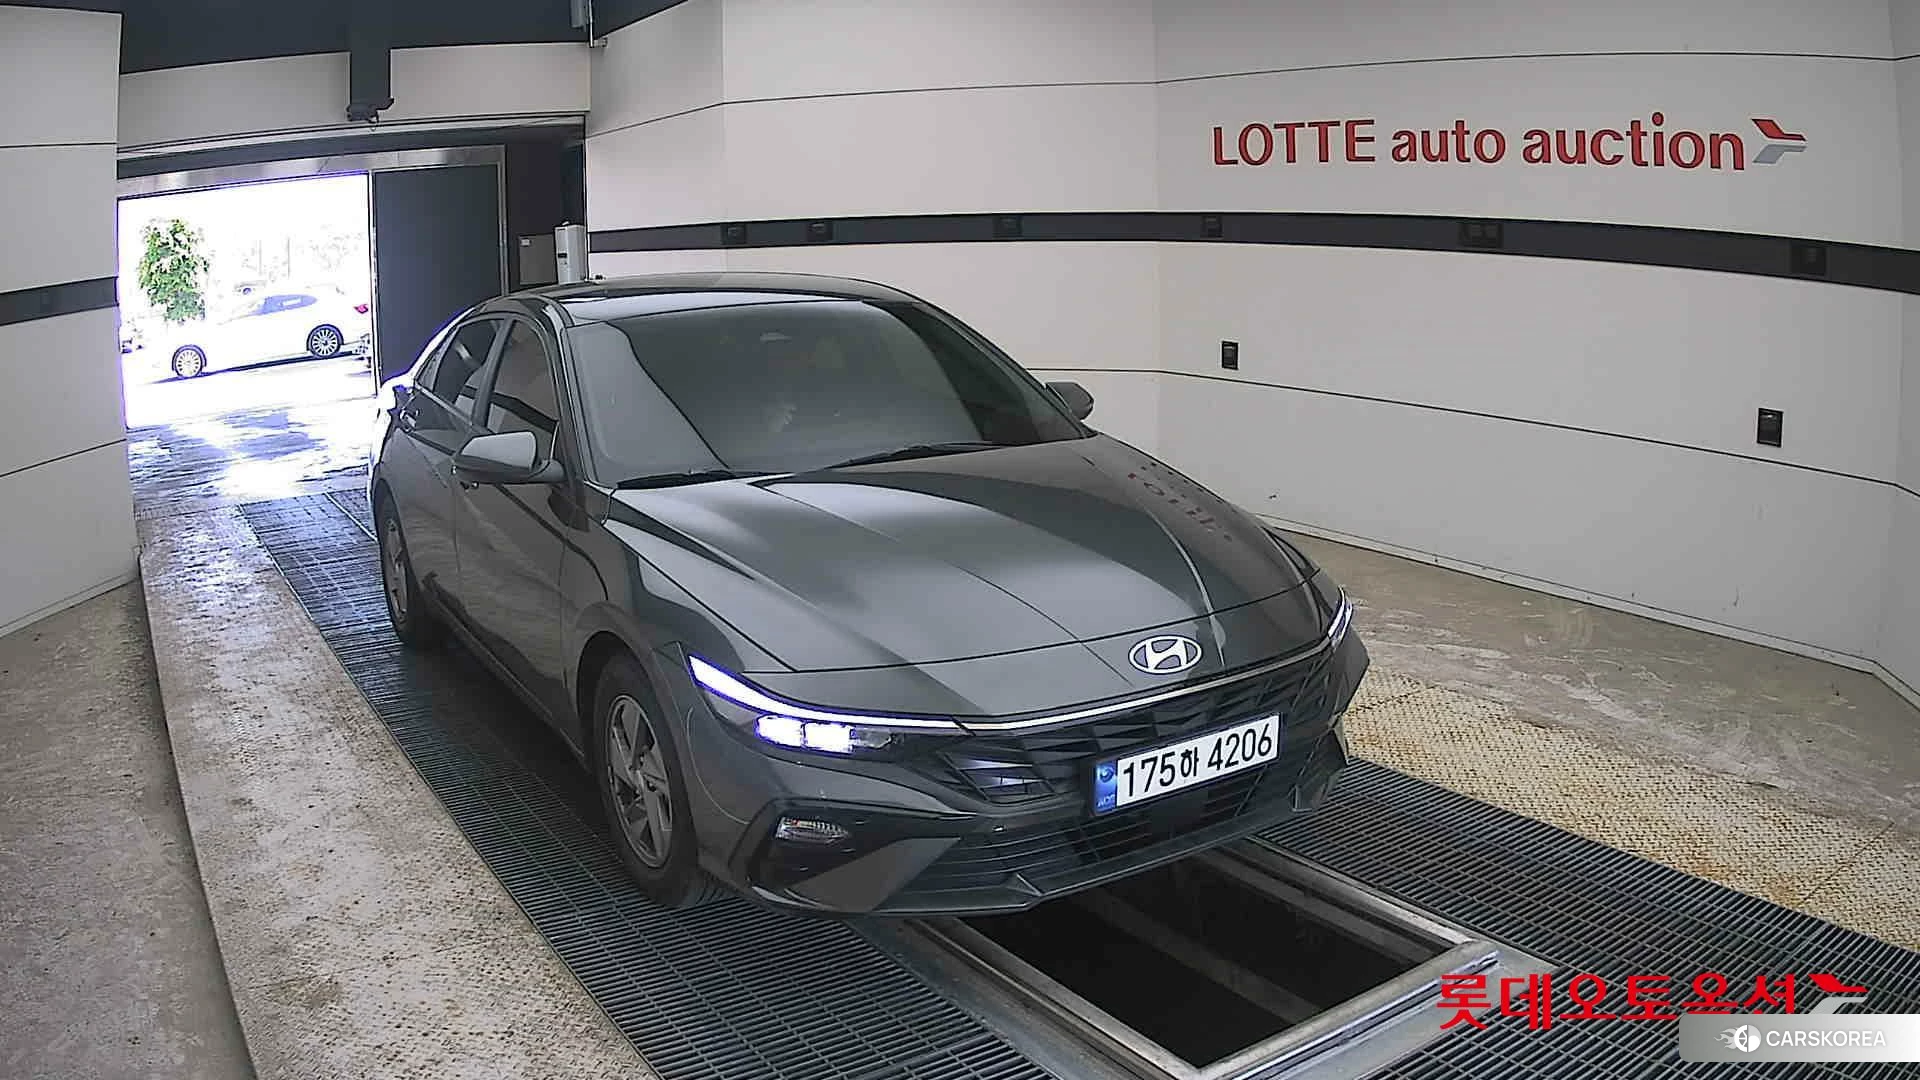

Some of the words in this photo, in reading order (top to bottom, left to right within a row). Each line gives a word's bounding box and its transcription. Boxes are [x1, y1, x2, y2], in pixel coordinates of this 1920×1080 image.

[1212, 119, 1376, 166] LOTTE
[1391, 119, 1507, 164] auto
[1522, 111, 1745, 171] auction
[1123, 746, 1200, 797] 175하
[1207, 723, 1273, 772] 4206
